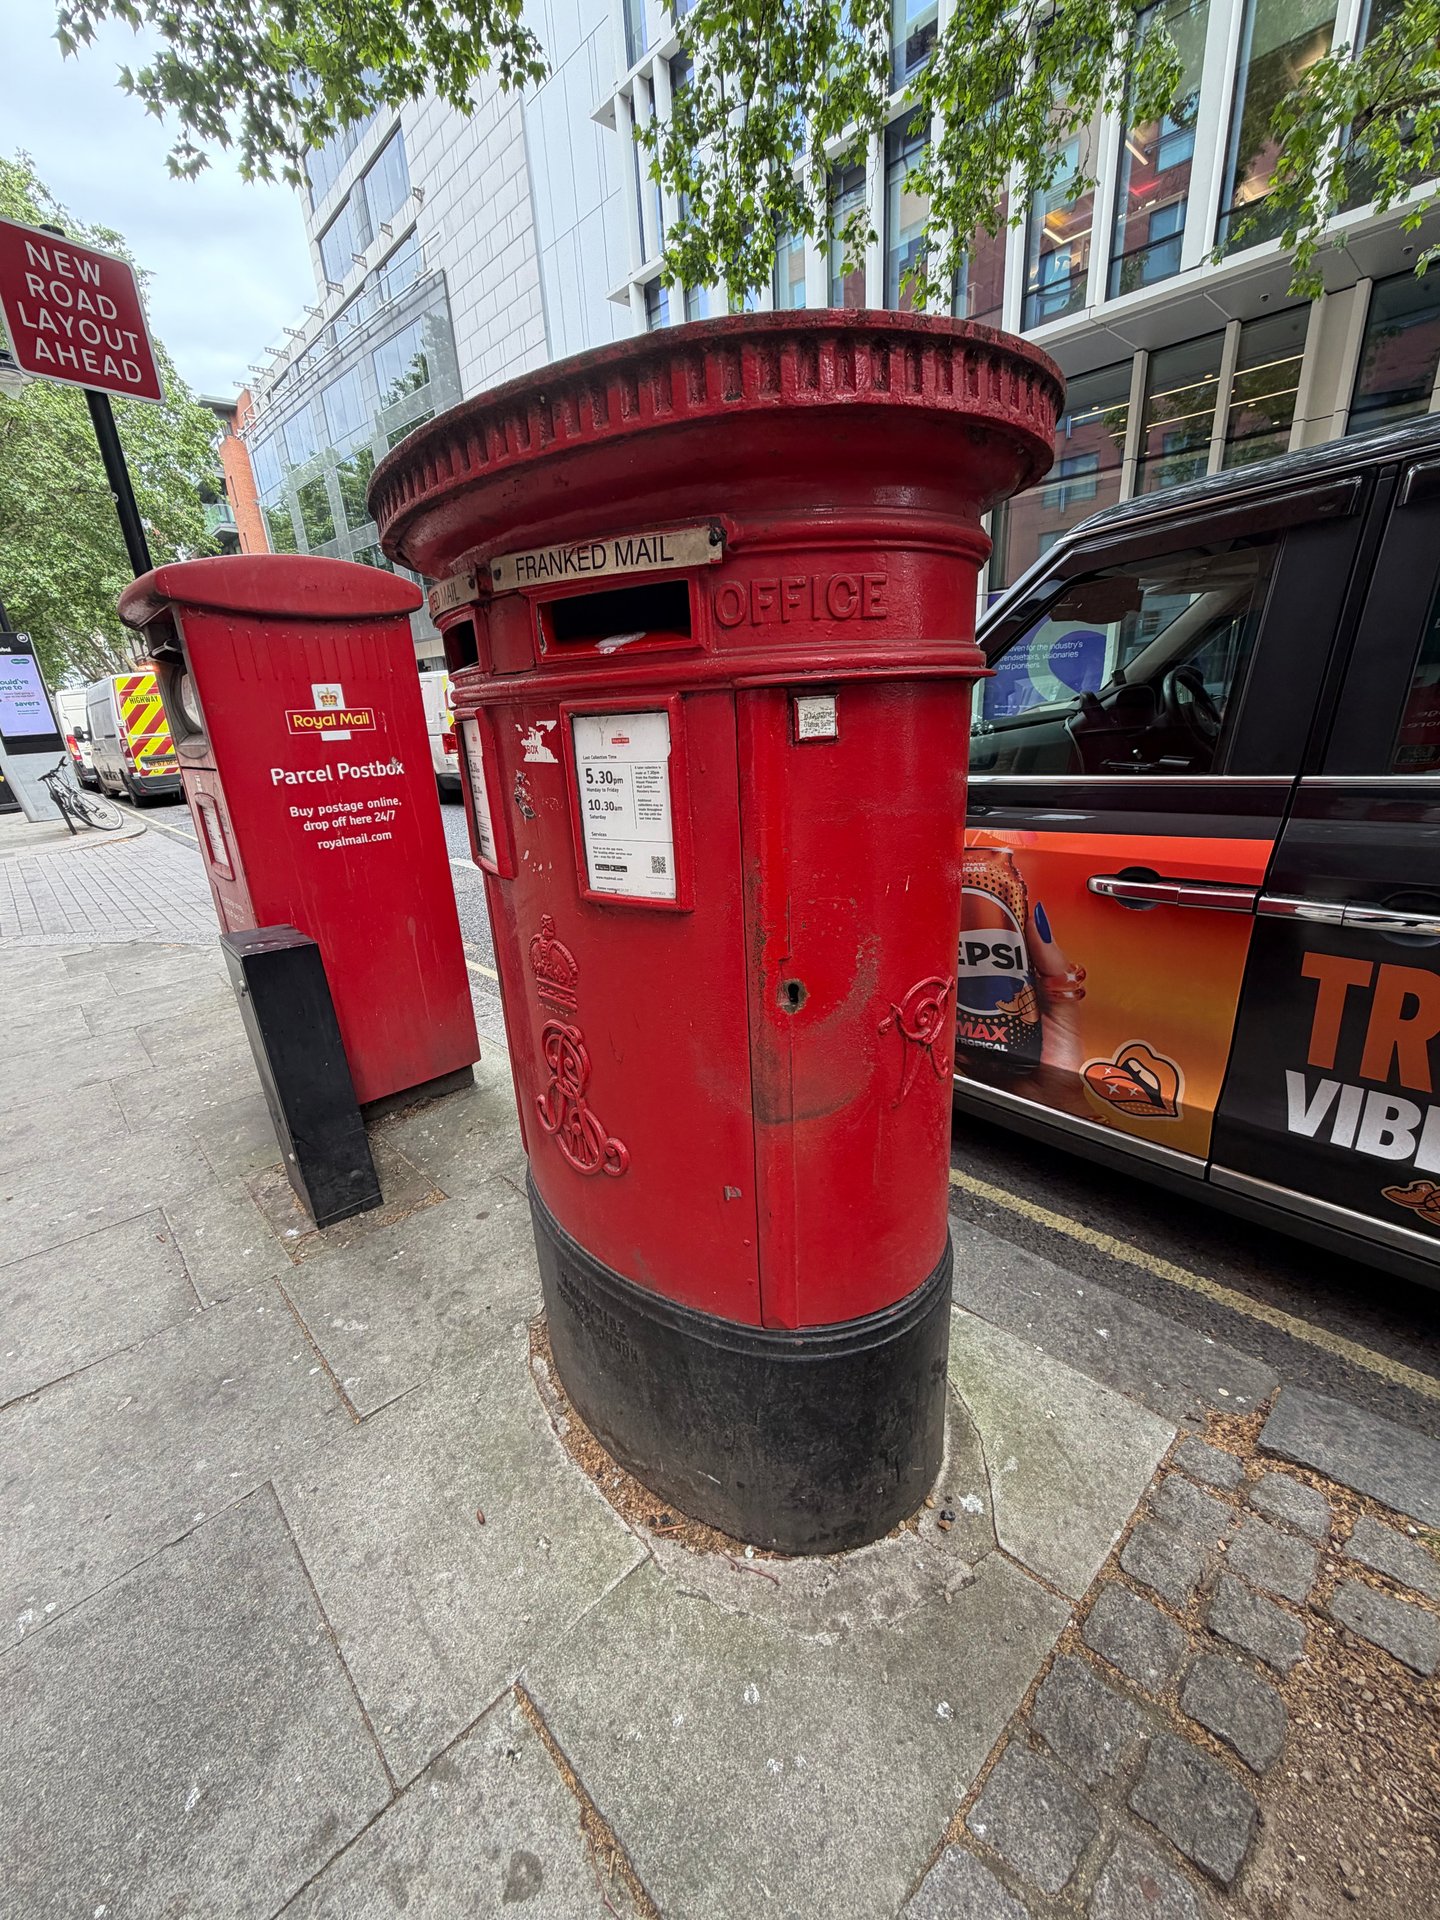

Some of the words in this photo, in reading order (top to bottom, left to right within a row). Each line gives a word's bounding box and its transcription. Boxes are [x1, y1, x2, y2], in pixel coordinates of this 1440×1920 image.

[25, 240, 100, 287] NEW
[25, 271, 118, 320] ROAD
[17, 300, 139, 356] LAYOUT
[35, 337, 142, 383] AHEAD
[515, 543, 607, 581] FRANKED
[615, 535, 674, 567] MAIL
[714, 572, 888, 627] OFFICE
[1037, 643, 1049, 651] the
[129, 695, 159, 704] HIGHWAY
[293, 713, 337, 729] Royal
[340, 712, 369, 726] Mail
[270, 764, 333, 786] Parcel
[337, 759, 405, 780] Postbox
[585, 768, 624, 785] 5.30pm
[289, 806, 314, 818] Buy
[317, 801, 364, 815] postage
[367, 796, 402, 809] online,
[588, 799, 623, 811] 10.30am
[303, 820, 329, 832] drop
[332, 816, 347, 828] off
[349, 813, 372, 826] here
[374, 810, 396, 823] 24/7
[317, 831, 392, 850] royalmail.com
[955, 1020, 1009, 1043] MAX
